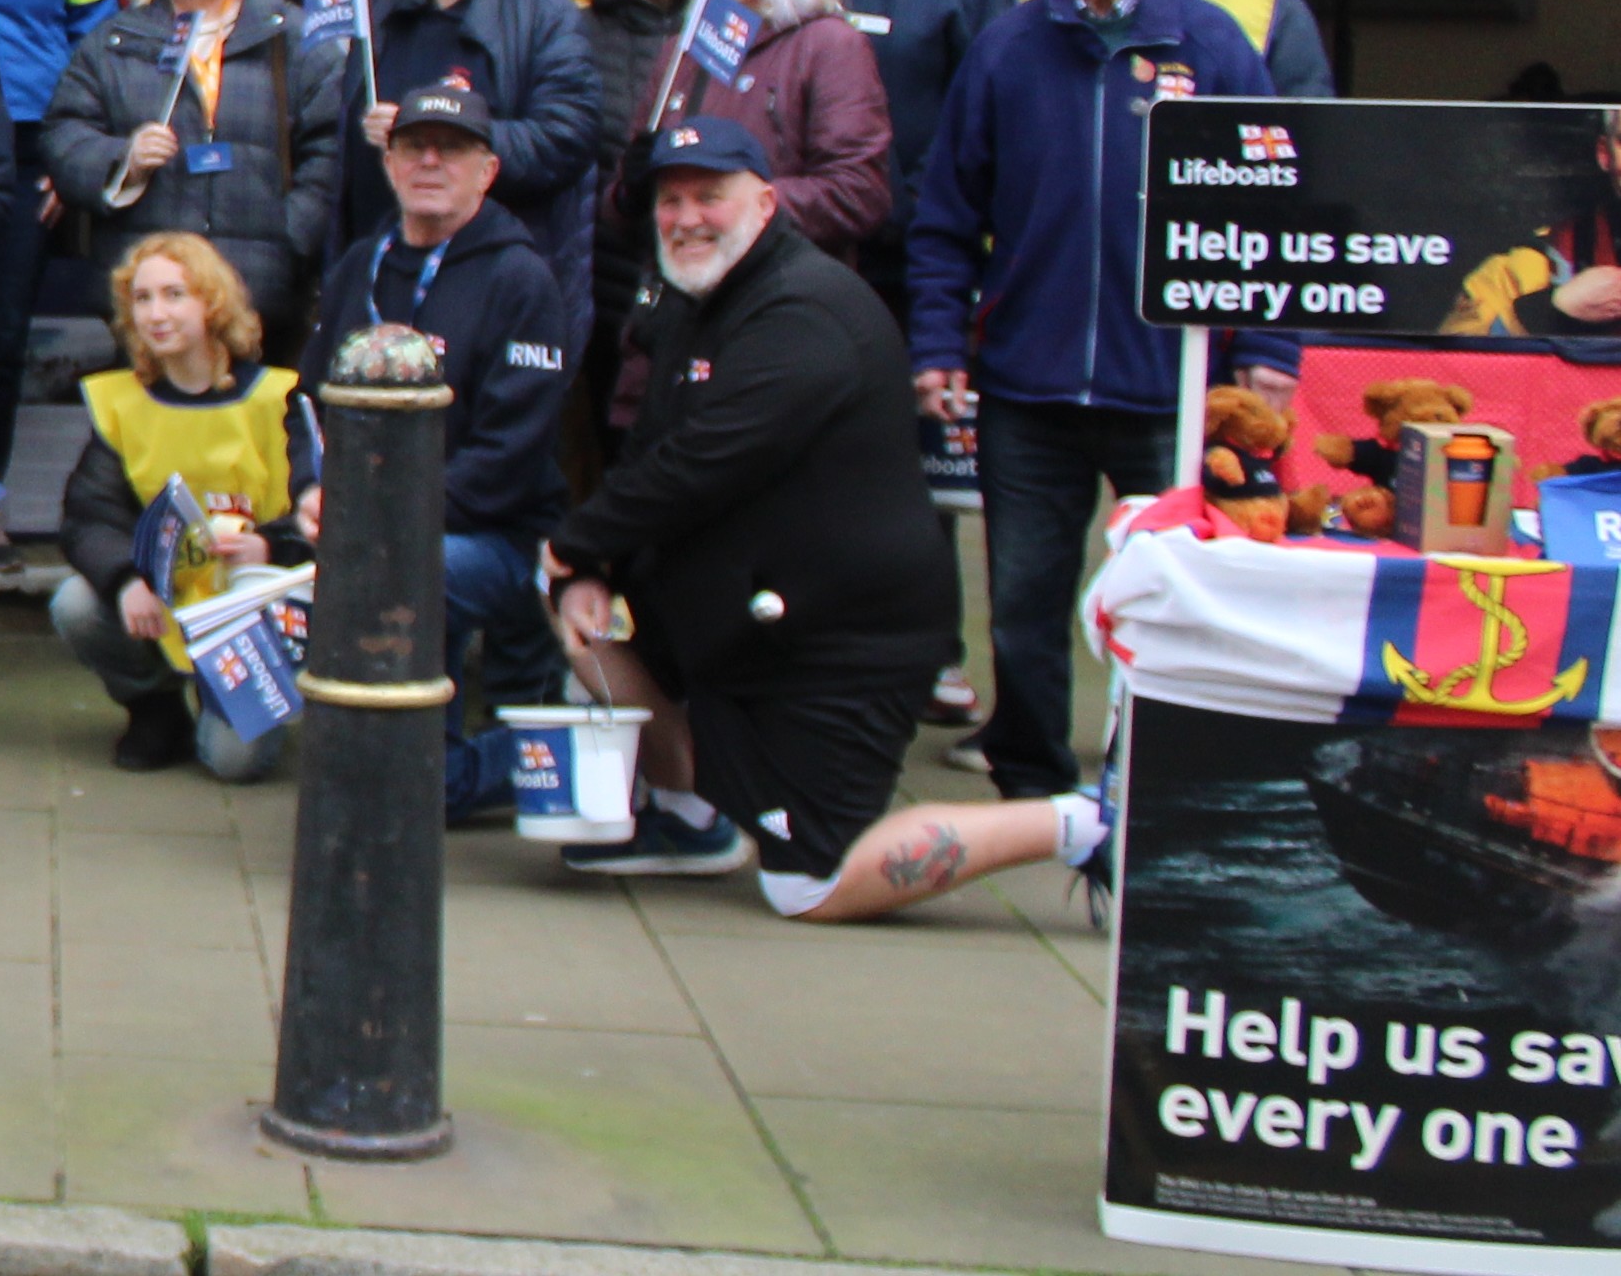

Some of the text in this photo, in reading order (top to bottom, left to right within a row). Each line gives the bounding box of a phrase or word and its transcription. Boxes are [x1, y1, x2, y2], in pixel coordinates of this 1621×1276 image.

[421, 95, 462, 114] RNLI
[1168, 159, 1299, 187] Lifeboats
[1164, 220, 1451, 270] Help us save
[1162, 280, 1385, 321] every one
[508, 342, 563, 371] RNLI
[234, 634, 292, 720] Lifeboats
[513, 769, 559, 789] boats
[1164, 985, 1359, 1085] Help
[1386, 1021, 1486, 1079] us
[1159, 1082, 1581, 1170] every one
